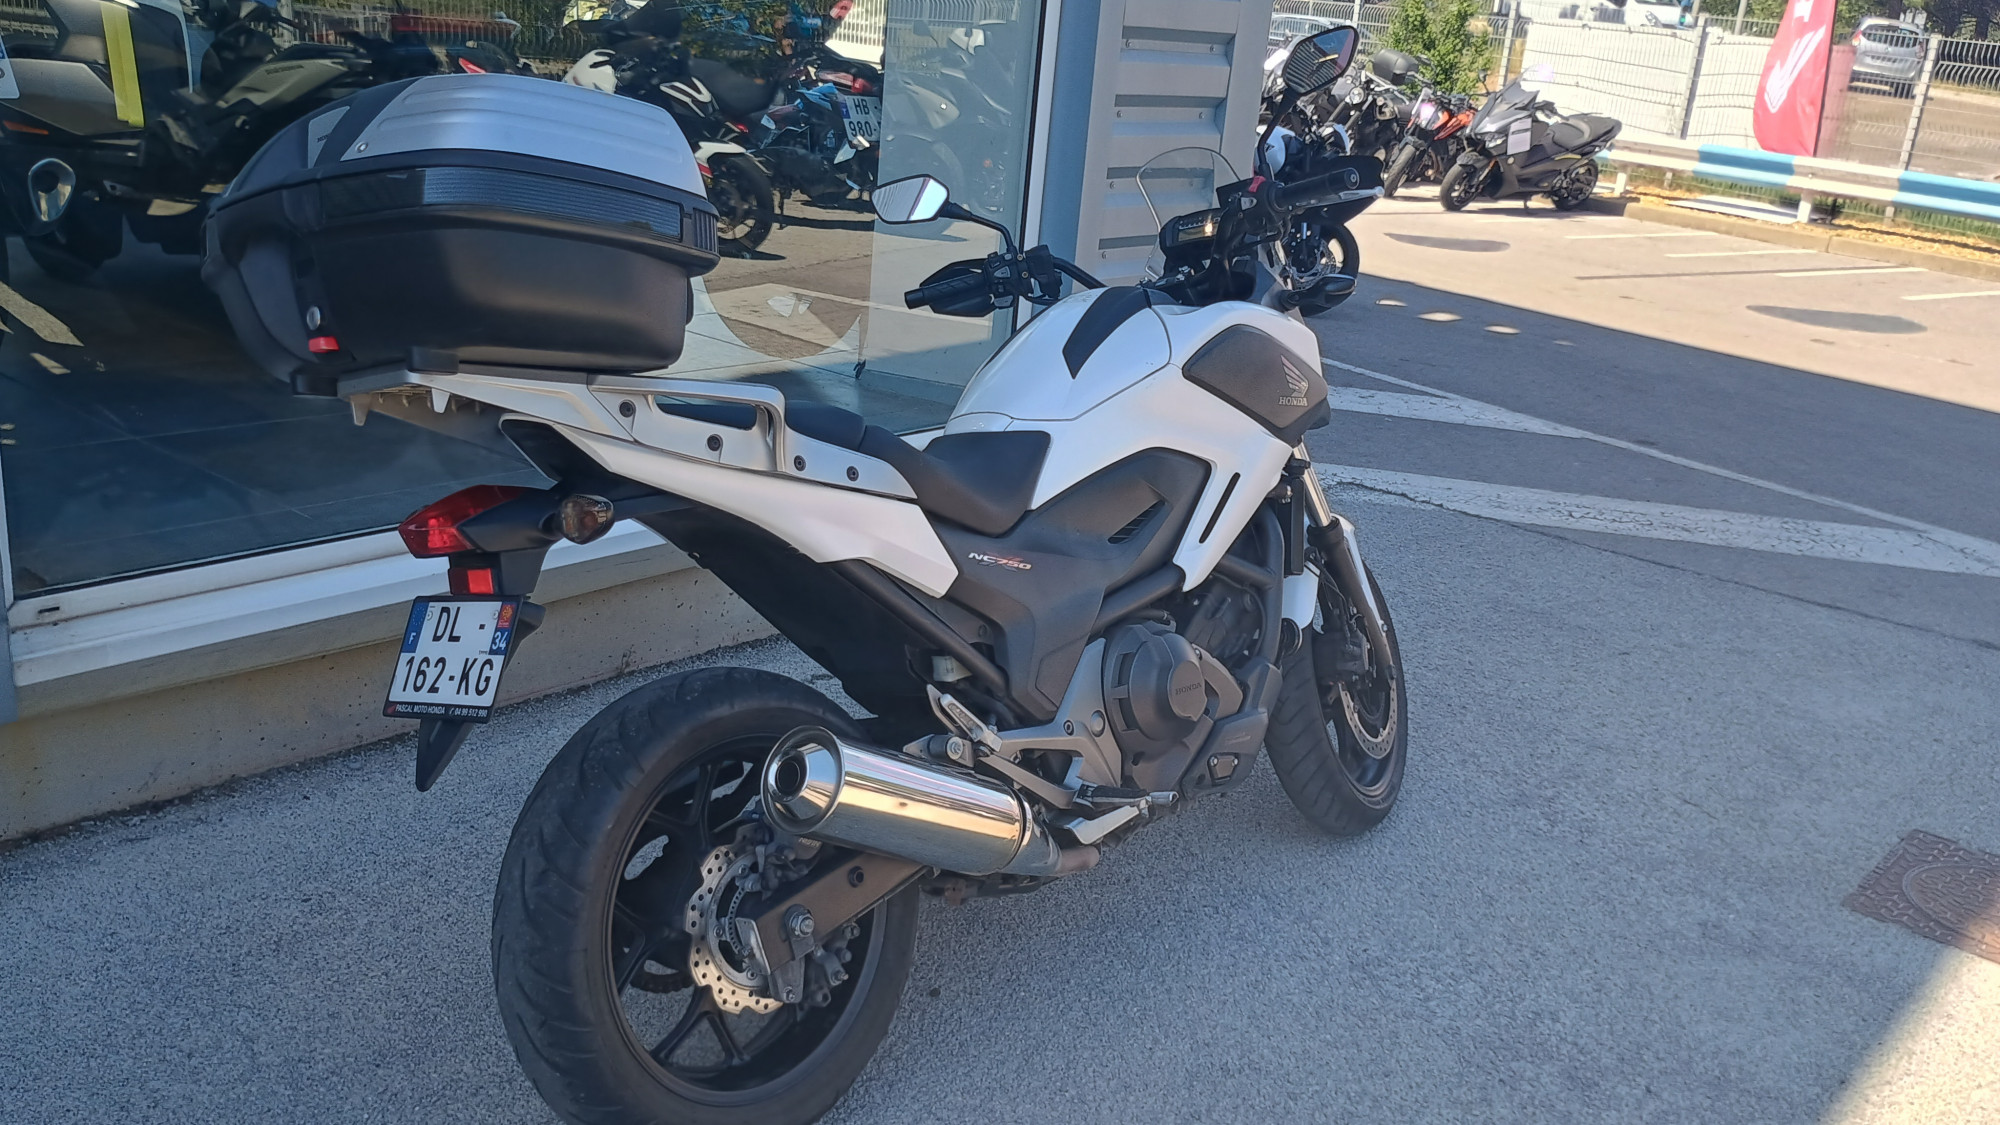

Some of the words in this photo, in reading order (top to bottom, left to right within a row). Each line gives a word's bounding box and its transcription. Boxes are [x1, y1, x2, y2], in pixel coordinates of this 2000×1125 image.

[853, 98, 870, 115] HB
[1279, 397, 1308, 406] HONDA
[432, 606, 461, 642] DL
[408, 632, 416, 644] F
[492, 631, 508, 651] 34
[402, 655, 494, 696] 162-KG
[1175, 683, 1202, 695] HONDA
[395, 704, 413, 712] PASCAL
[413, 705, 427, 713] MOTO
[427, 706, 445, 714] HONDA
